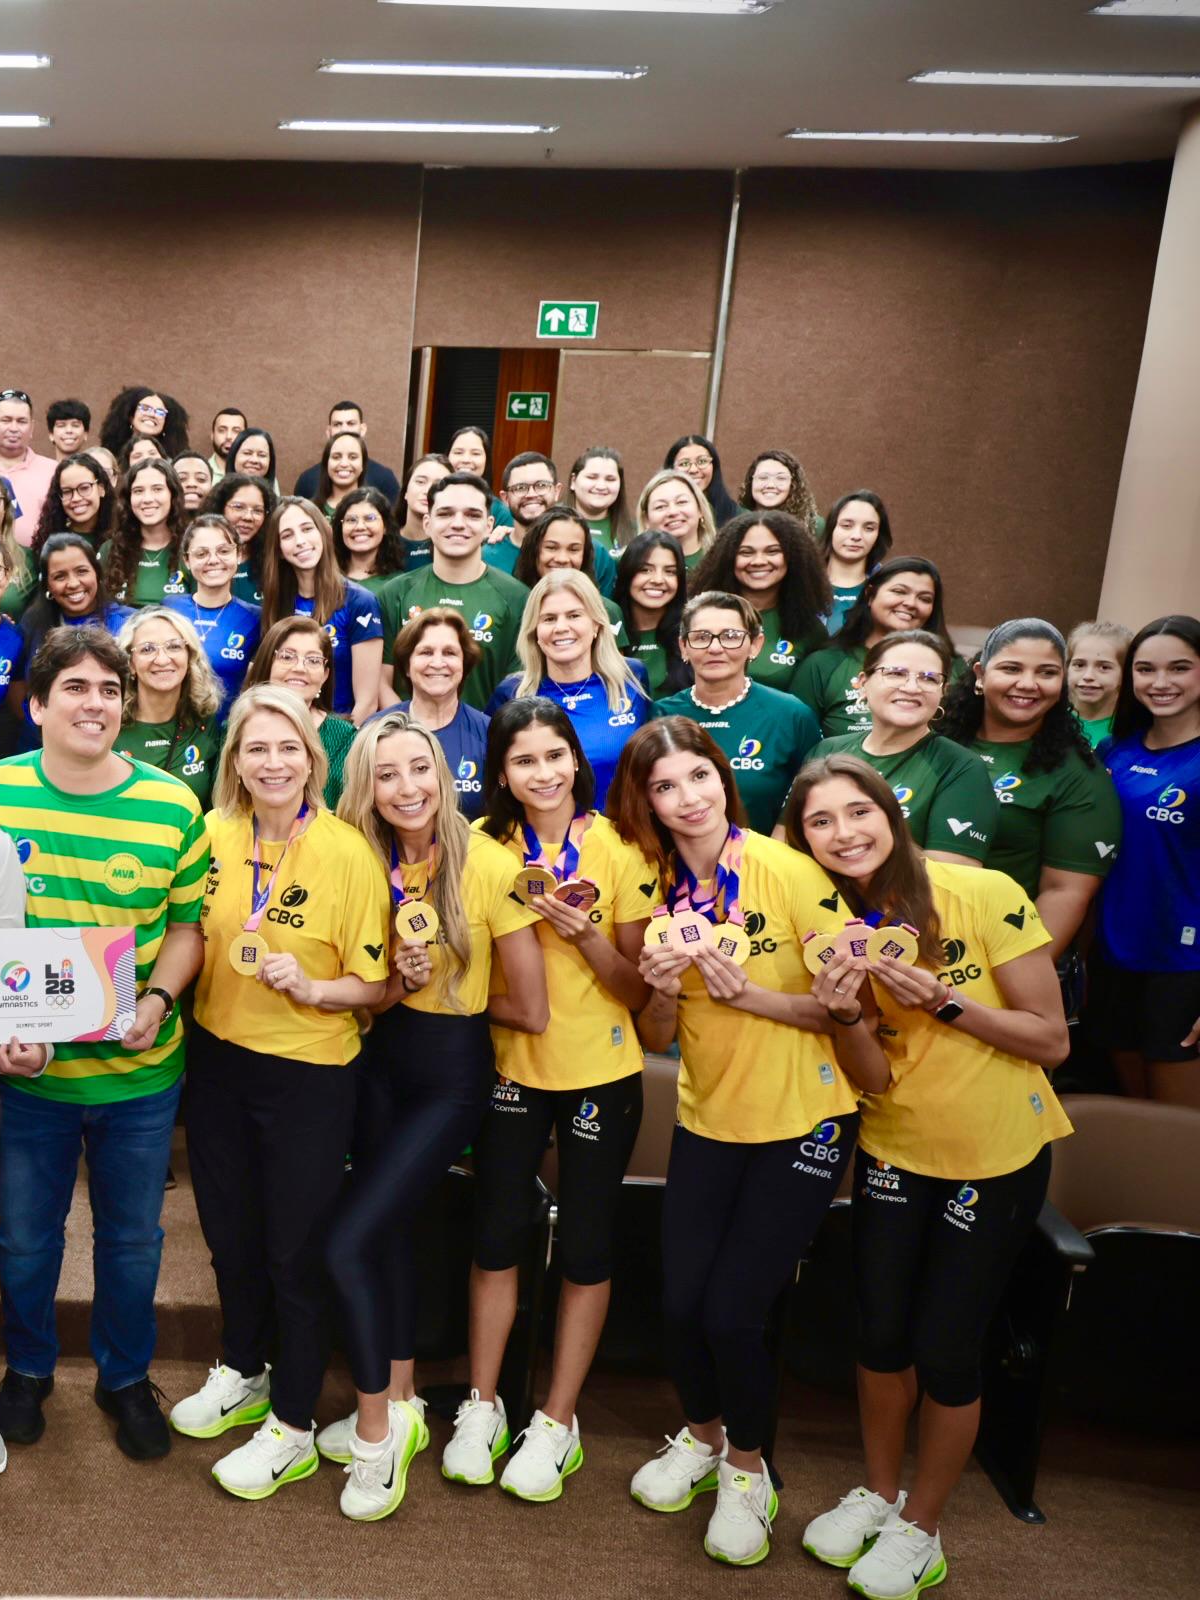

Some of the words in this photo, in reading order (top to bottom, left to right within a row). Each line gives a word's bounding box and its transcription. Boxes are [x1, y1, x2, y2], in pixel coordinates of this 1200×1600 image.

[163, 584, 185, 593] CBG
[220, 648, 244, 660] CBG
[769, 653, 796, 666] CBG
[608, 713, 636, 727] CBG
[729, 757, 765, 770] CBG
[453, 780, 482, 792] CBG
[1145, 806, 1185, 824] CBG
[969, 830, 987, 843] VALE
[112, 868, 135, 879] MVA
[266, 907, 305, 928] CBG
[750, 938, 777, 956] BG
[45, 959, 74, 979] LA
[937, 964, 982, 987] CBG
[45, 979, 75, 995] 28
[494, 1103, 528, 1113] Correios
[572, 1116, 601, 1132] CBG
[800, 1141, 840, 1163] CBG
[866, 1167, 900, 1181] loterias
[867, 1176, 899, 1190] CAIXA
[871, 1191, 908, 1203] Correios
[947, 1200, 977, 1222] CBG
